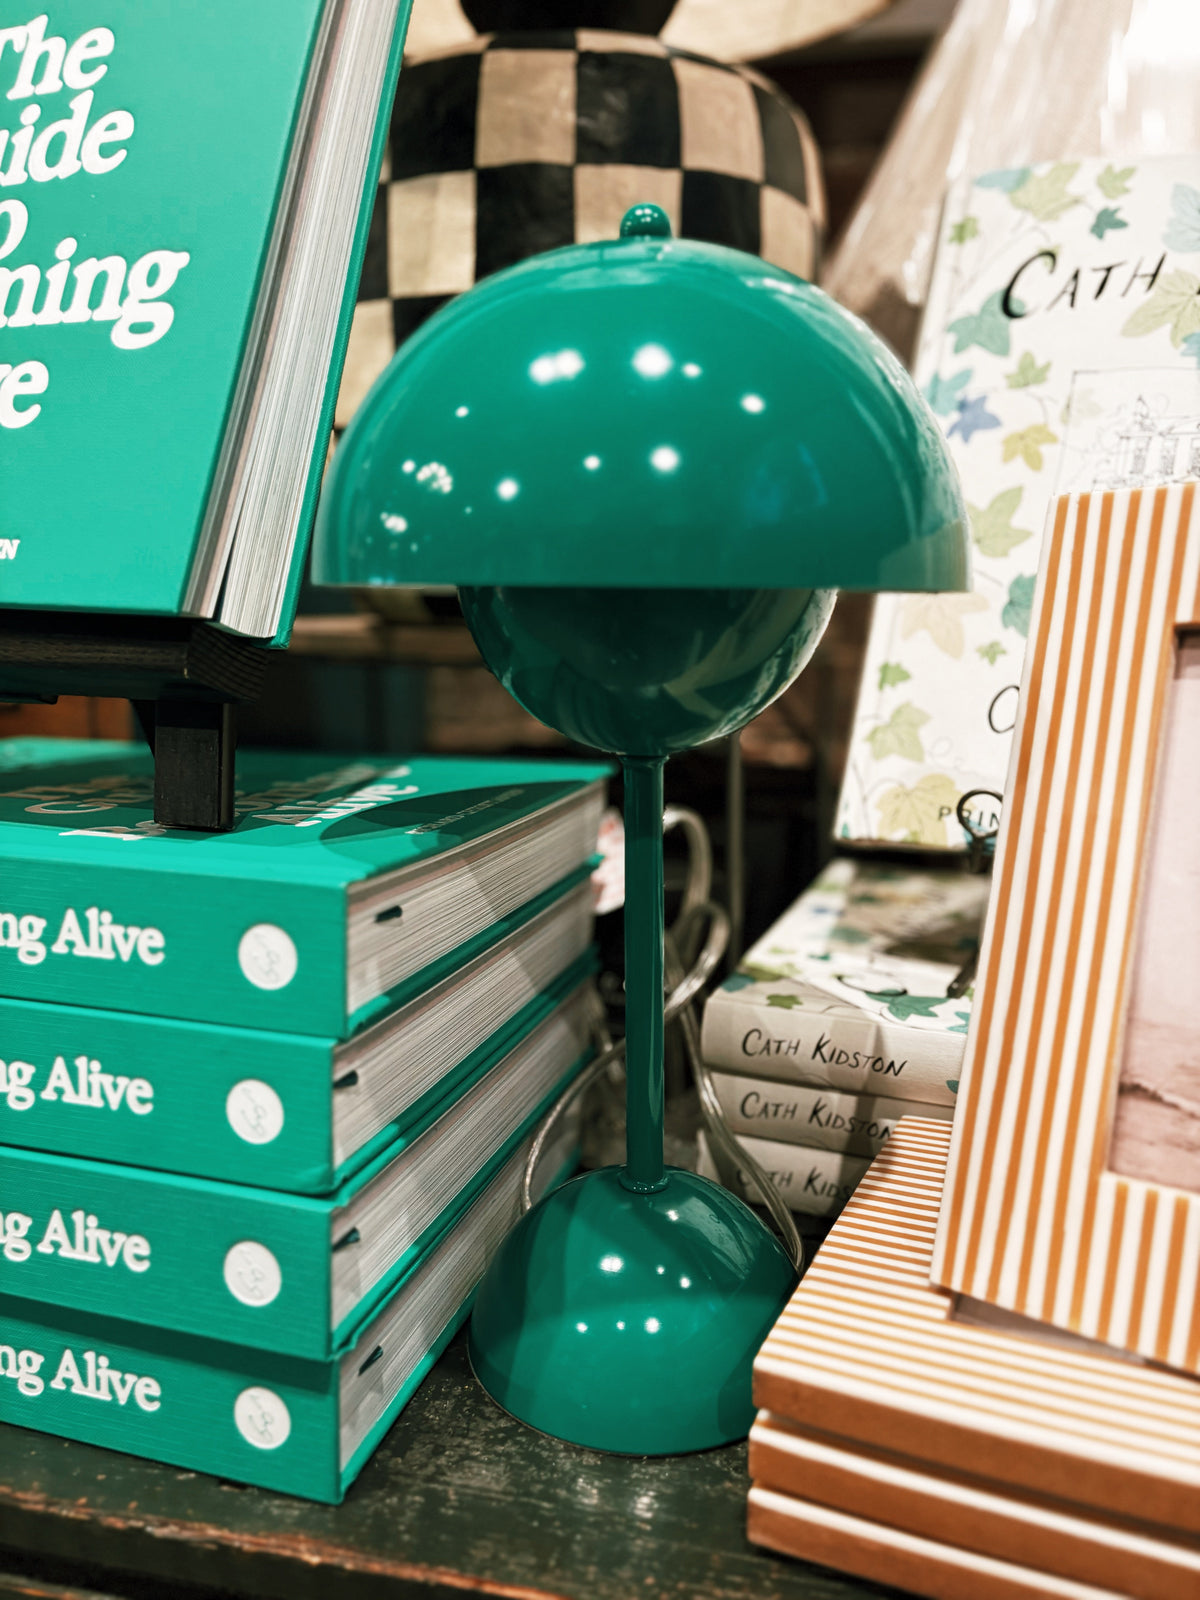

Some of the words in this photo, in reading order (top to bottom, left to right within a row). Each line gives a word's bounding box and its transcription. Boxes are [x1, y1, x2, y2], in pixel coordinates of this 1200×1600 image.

[1002, 250, 1167, 319] CATH
[51, 906, 166, 966] Alive
[741, 1028, 801, 1057] CATH
[811, 1032, 908, 1077] KIDSTON
[40, 1055, 154, 1115] Alive
[740, 1091, 798, 1119] CATH
[37, 1208, 151, 1273] Alive
[50, 1348, 162, 1412] Alive
